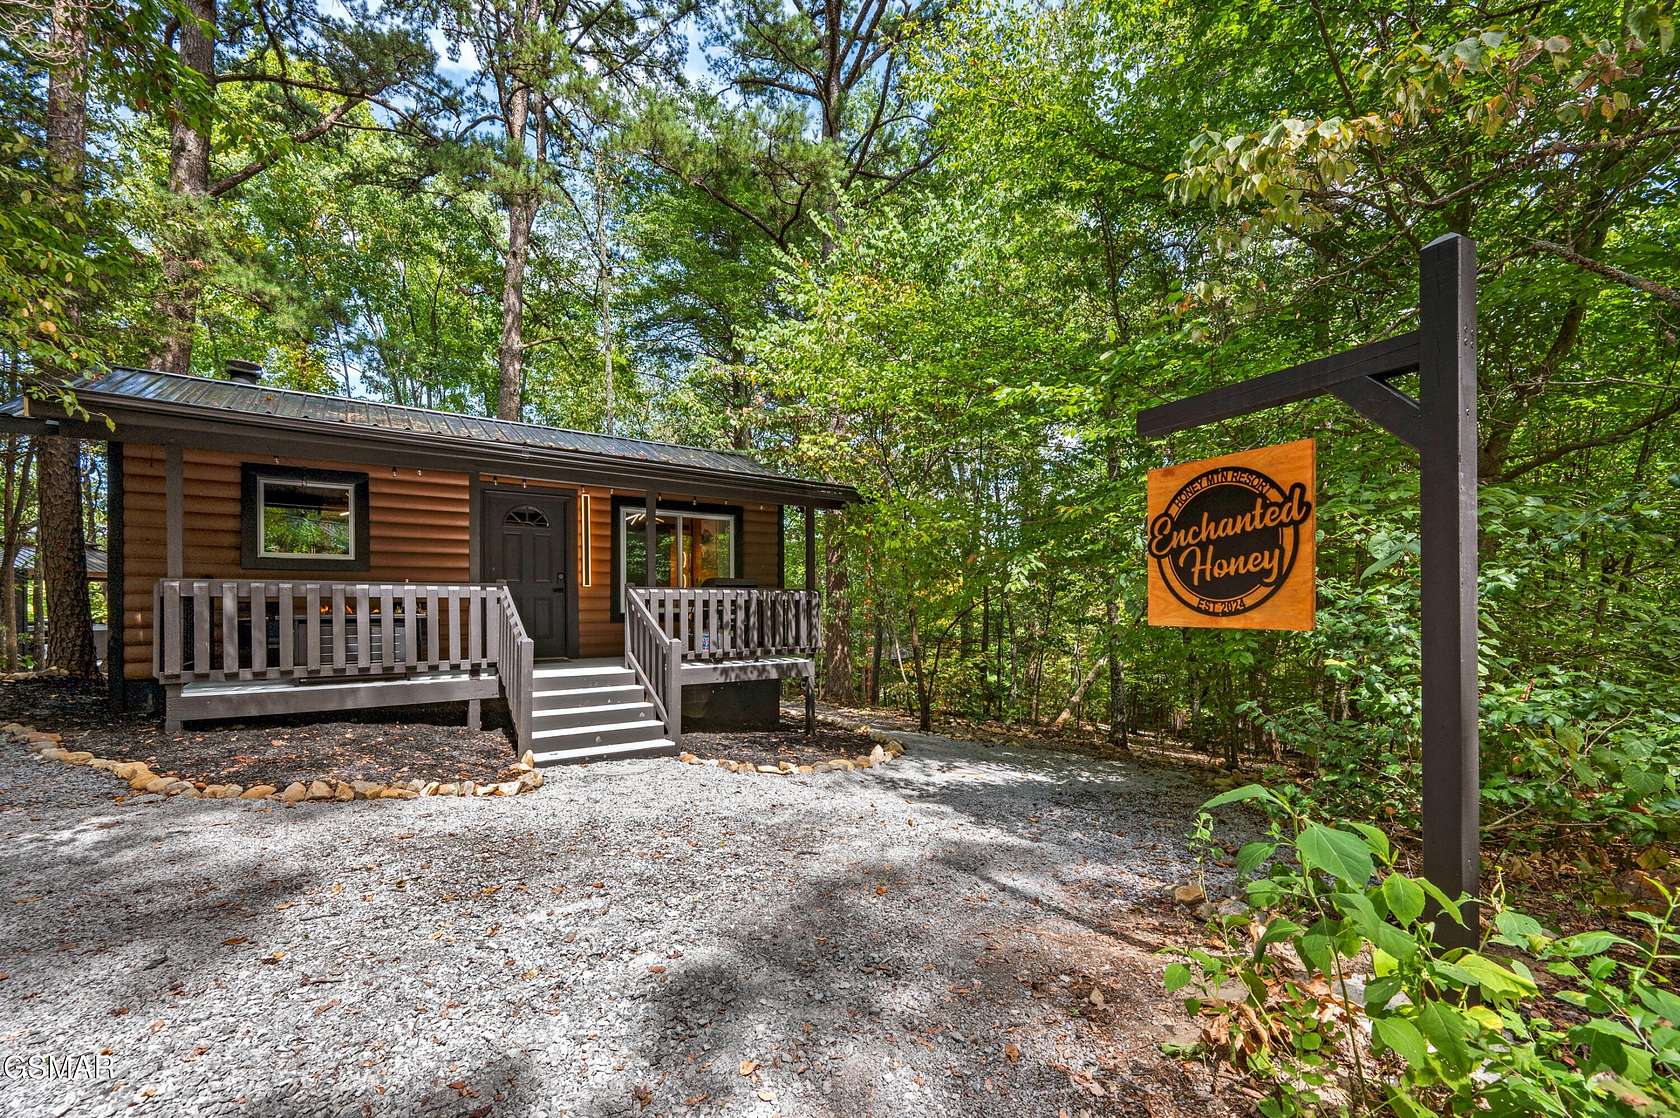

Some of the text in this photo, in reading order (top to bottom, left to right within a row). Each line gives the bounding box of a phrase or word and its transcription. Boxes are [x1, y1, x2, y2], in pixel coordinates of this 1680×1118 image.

[1174, 477, 1204, 507] HONEY
[1232, 471, 1270, 494] RESORT
[1151, 487, 1306, 556] Enchanted
[1179, 545, 1280, 586] Honey
[1197, 597, 1246, 612] EST 2024
